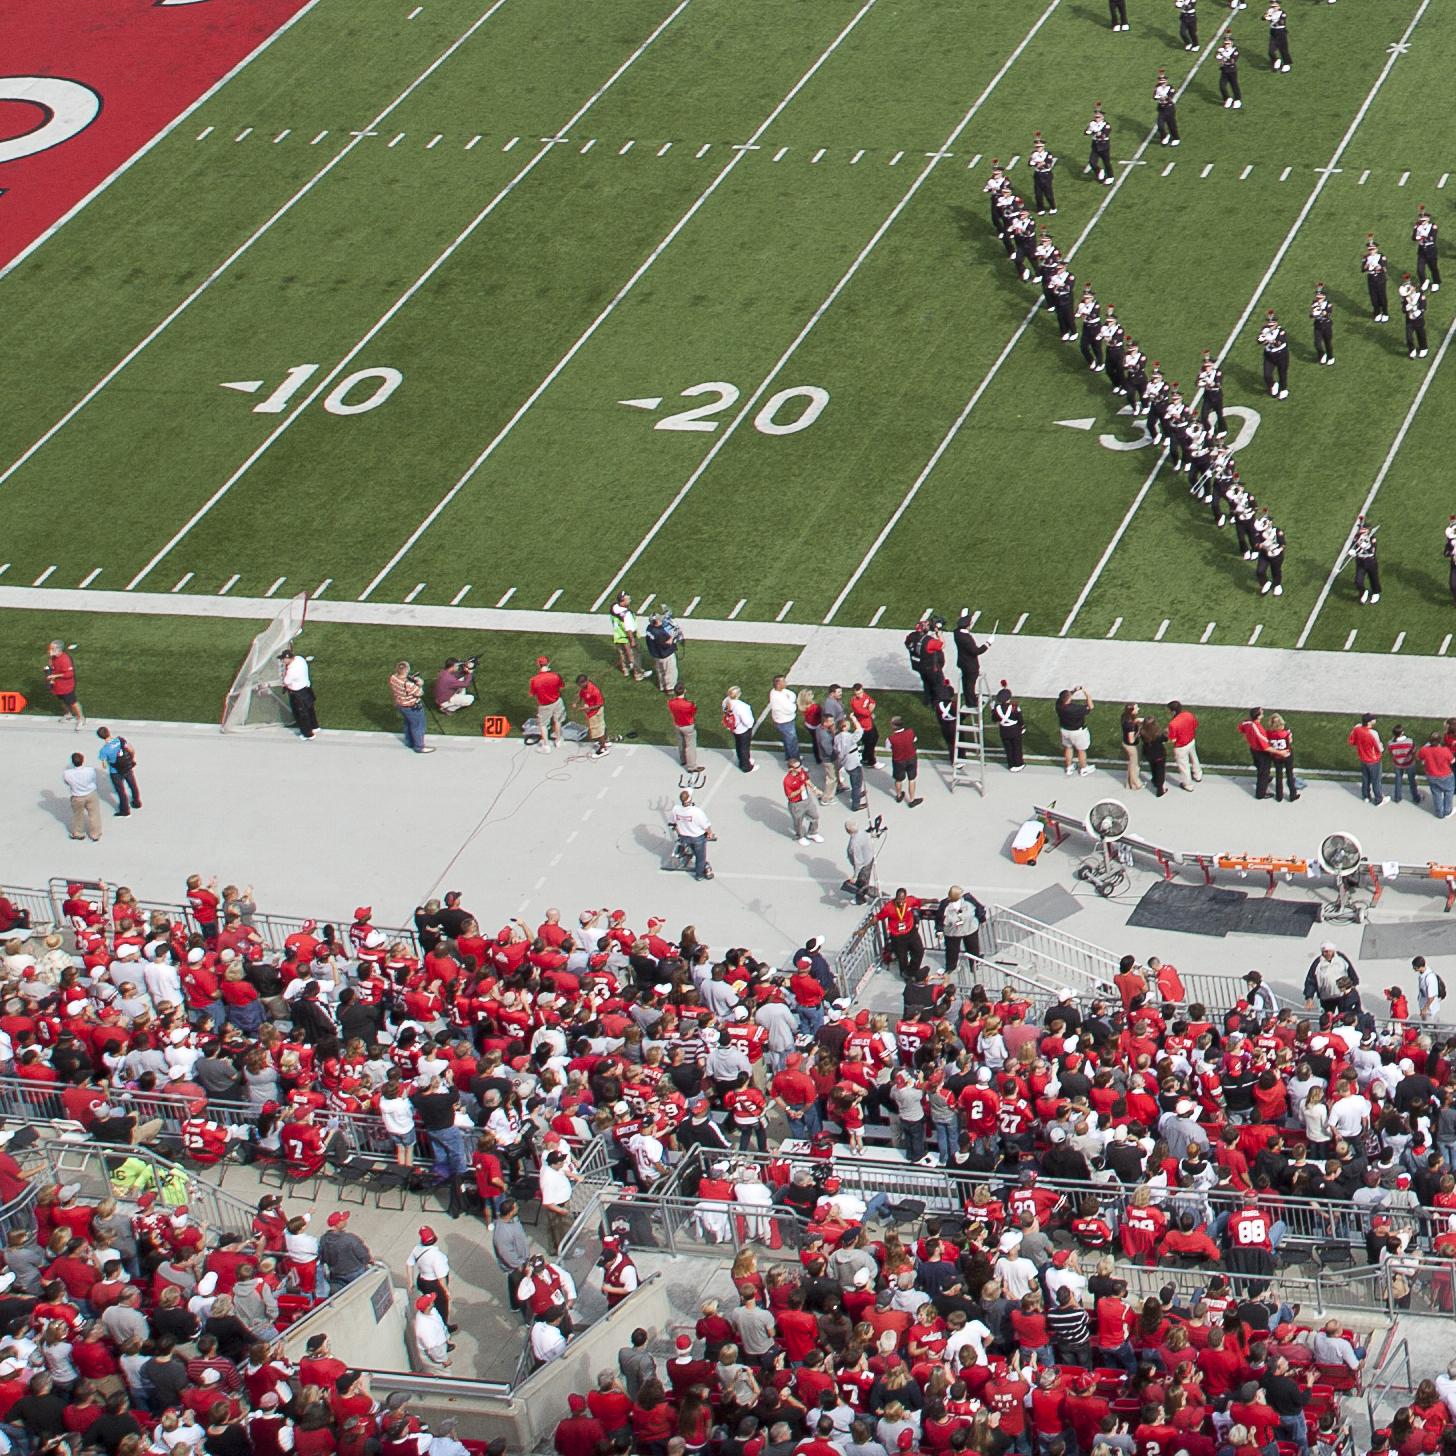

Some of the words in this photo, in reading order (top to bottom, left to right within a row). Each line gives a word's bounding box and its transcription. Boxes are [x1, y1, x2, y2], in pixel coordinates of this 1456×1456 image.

[252, 363, 403, 416] 10
[654, 381, 830, 436] 20
[1, 694, 16, 711] 10
[486, 717, 502, 735] 20
[970, 1100, 984, 1120] 2
[1000, 1114, 1021, 1134] 27
[289, 1139, 303, 1160] 7
[1238, 1219, 1266, 1244] 88
[842, 1384, 859, 1404] 7
